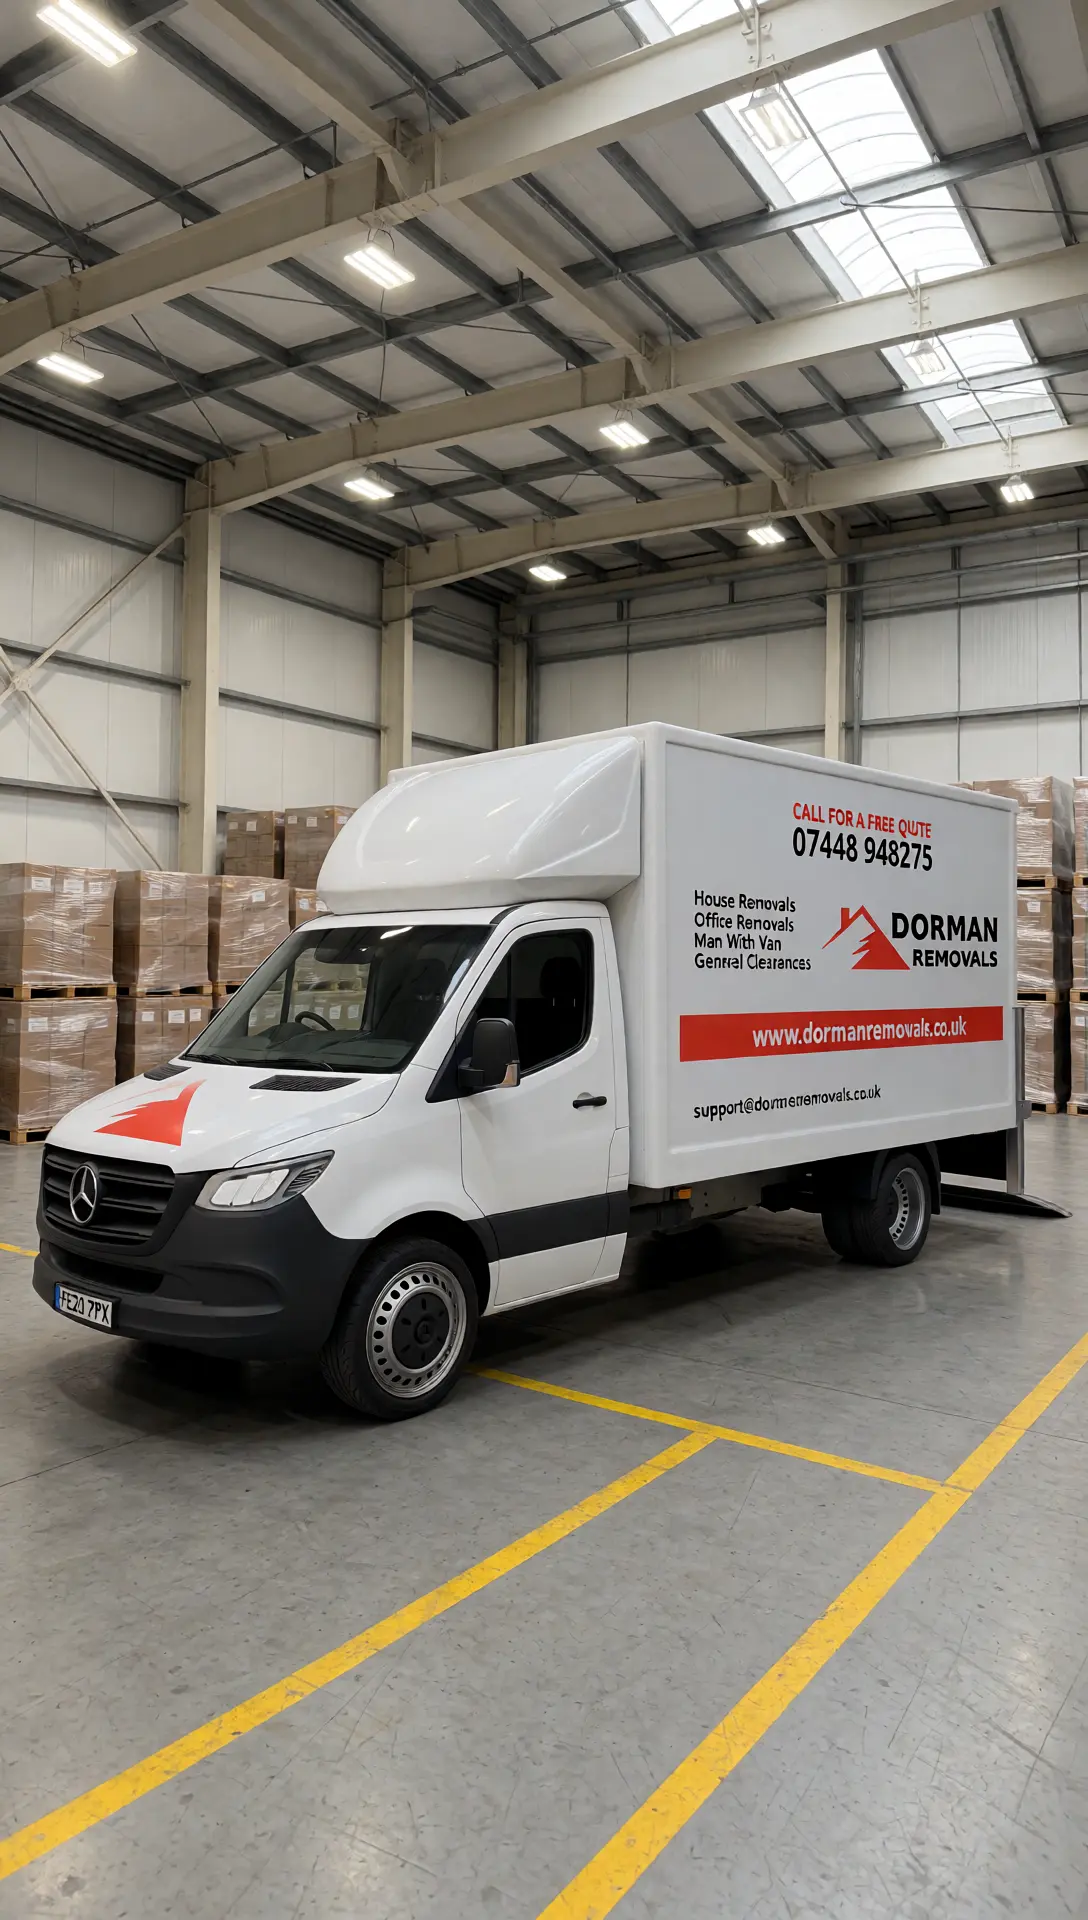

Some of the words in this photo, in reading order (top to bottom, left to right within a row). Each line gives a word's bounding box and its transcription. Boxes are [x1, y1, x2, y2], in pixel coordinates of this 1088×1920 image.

[793, 802, 825, 823] CALL
[828, 808, 854, 827] FOR
[856, 812, 865, 829] A
[867, 813, 895, 834] FREE
[793, 827, 858, 862] 07448
[864, 837, 932, 871] 948275
[694, 890, 735, 909] House
[694, 912, 733, 929] Office
[892, 912, 998, 942] DORMAN
[694, 933, 722, 949] Man
[727, 933, 755, 950] With
[759, 935, 782, 951] Van
[913, 949, 998, 968] REMOVALS
[752, 1015, 967, 1048] www.dormanremovals.co.uk
[88, 1299, 109, 1324] 7PX
